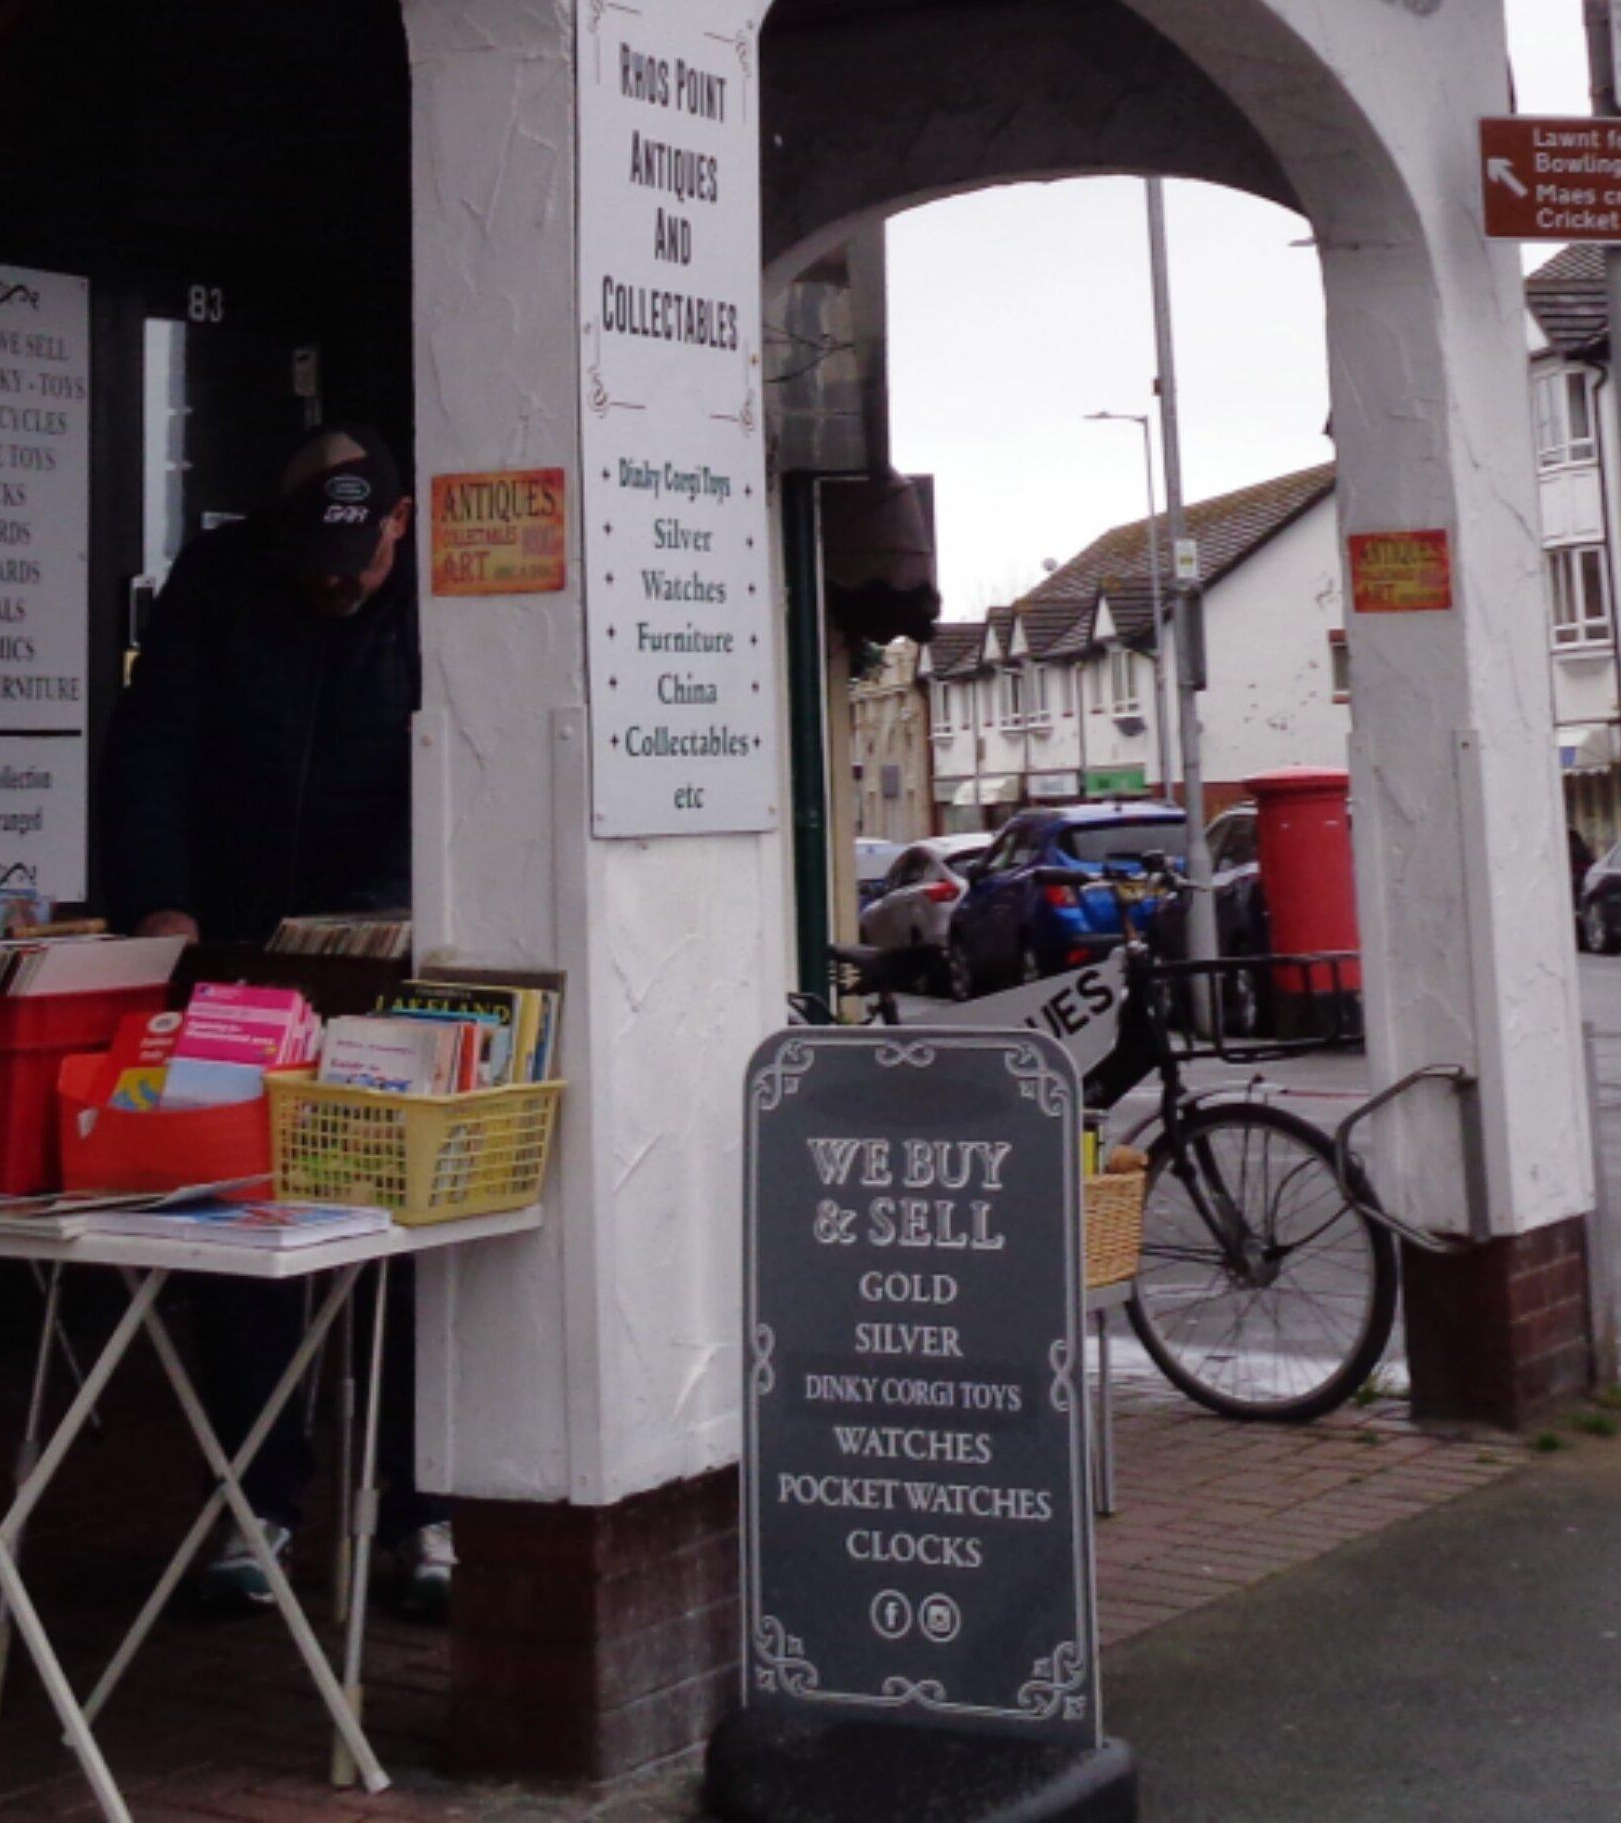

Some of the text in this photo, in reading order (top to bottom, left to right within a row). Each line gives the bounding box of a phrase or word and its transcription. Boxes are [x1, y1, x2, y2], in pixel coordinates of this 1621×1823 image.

[620, 41, 725, 123] RHOS POINT
[1533, 128, 1599, 149] Lawnt
[630, 129, 717, 203] ANTIQUES
[1535, 184, 1596, 206] Maes
[1536, 207, 1619, 229] Cricket
[655, 207, 691, 266] AND
[188, 284, 223, 322] 83
[602, 275, 737, 351] COLLECTABLES
[26, 333, 69, 361] SELL
[39, 372, 87, 399] TOYS
[10, 444, 57, 471] TOYS
[619, 456, 731, 504] Dinky Corgi Toys
[441, 479, 556, 523] ANTIQUES
[654, 518, 713, 552] Silver
[443, 550, 490, 583] ART
[642, 569, 727, 604] Watches
[637, 622, 733, 653] Furniture
[658, 673, 717, 705] China
[625, 726, 749, 757] Collectables
[674, 784, 705, 809] etc
[806, 1137, 1012, 1190] WE BUY
[813, 1196, 1005, 1250] & SELL
[859, 1271, 958, 1304] GOLD
[855, 1322, 964, 1357] SILVER
[806, 1374, 1022, 1412] DINKY CORGI TOYS
[833, 1425, 992, 1464] WATCHES
[778, 1472, 1053, 1521] POCKET WATCHES
[846, 1529, 983, 1568] CLOCKS
